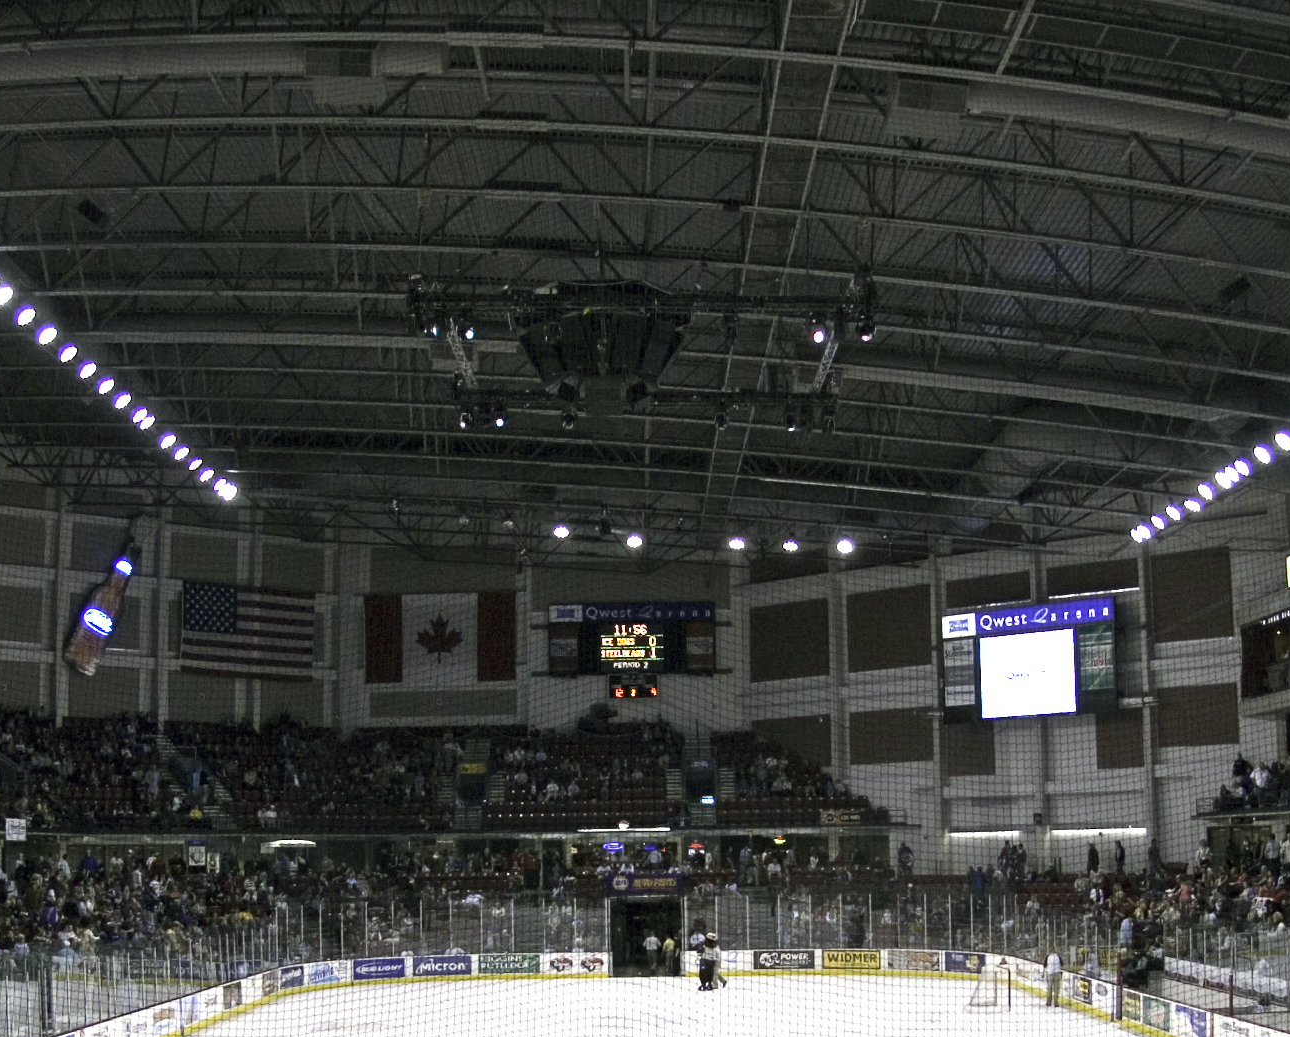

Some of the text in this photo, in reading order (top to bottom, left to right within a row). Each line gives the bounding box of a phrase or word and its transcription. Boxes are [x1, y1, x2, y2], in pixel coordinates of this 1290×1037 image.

[585, 606, 632, 620] Qwest
[980, 613, 1027, 630] Qwest
[1050, 607, 1109, 622] arena
[613, 624, 648, 636] 11:56
[648, 635, 656, 647] 0
[613, 661, 640, 669] PERIOD
[827, 953, 878, 964] WIDMER
[416, 958, 466, 974] Micron
